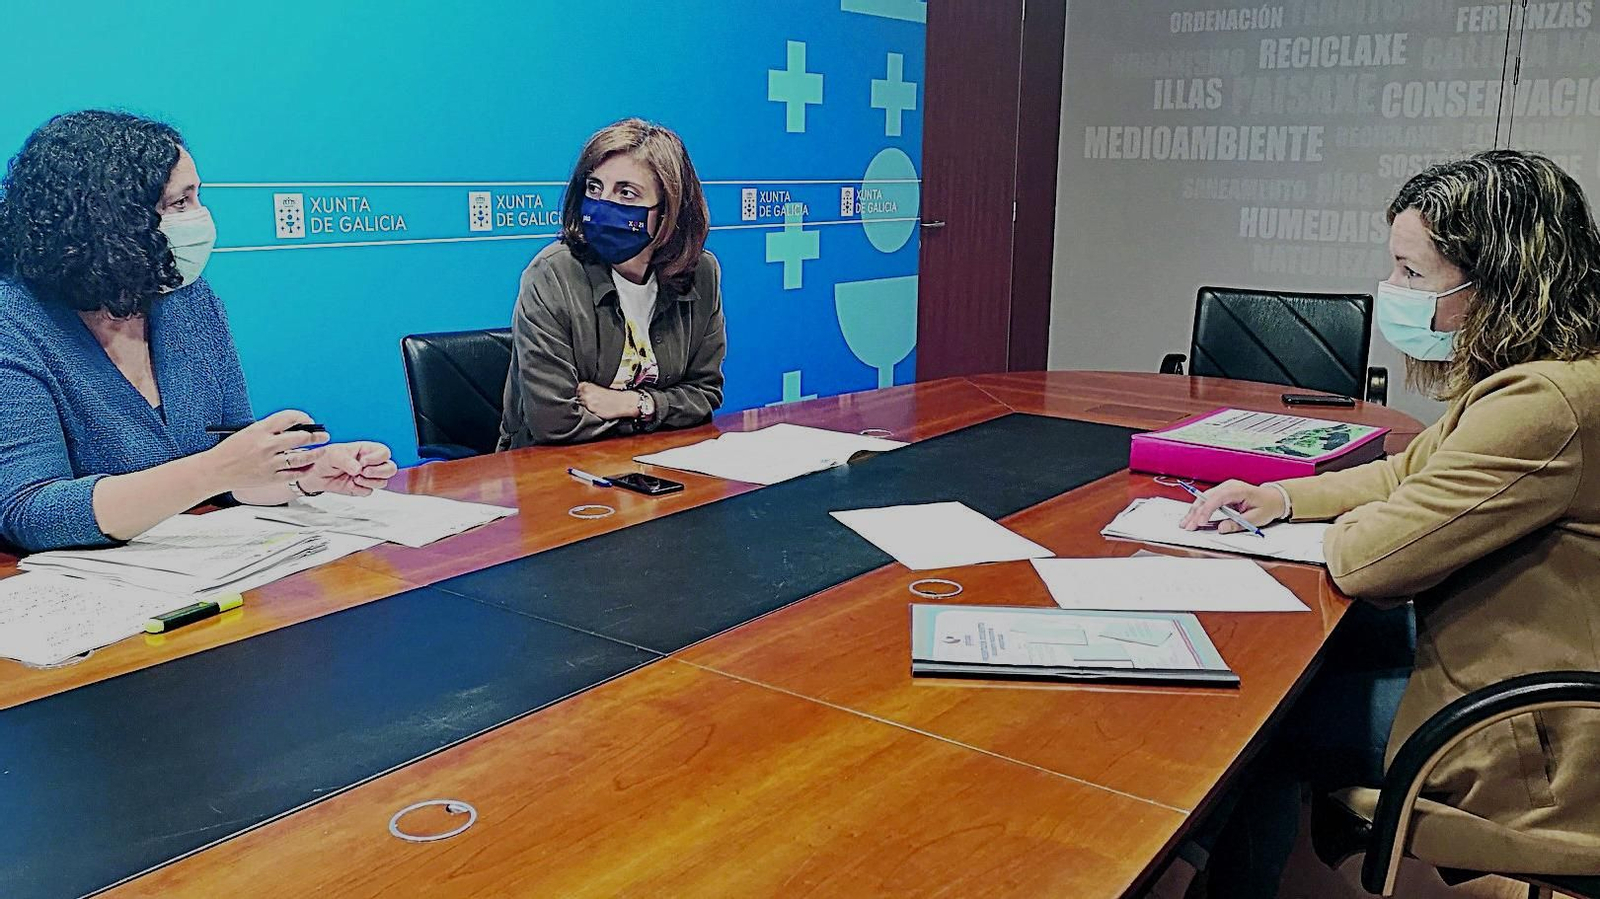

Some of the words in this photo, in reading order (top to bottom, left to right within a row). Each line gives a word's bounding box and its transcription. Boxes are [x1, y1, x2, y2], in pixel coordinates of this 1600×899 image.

[1170, 4, 1284, 34] ORDENACIÓN
[1259, 32, 1409, 70] RECICLAXE
[1153, 77, 1223, 111] ILLAS
[1083, 125, 1326, 162] MEDIOAMBIENTE
[496, 194, 543, 209] XUNTA
[759, 190, 791, 203] XUNTA
[855, 188, 882, 200] XUNTA
[310, 196, 371, 213] XUNTA
[759, 205, 771, 217] DE
[773, 204, 809, 217] GALICIA
[855, 202, 867, 214] DE
[868, 201, 898, 213] GALICIA
[311, 217, 334, 233] DE
[339, 215, 407, 233] GALICIA
[496, 212, 514, 227] DE
[1238, 206, 1390, 244] HUMEDAIS
